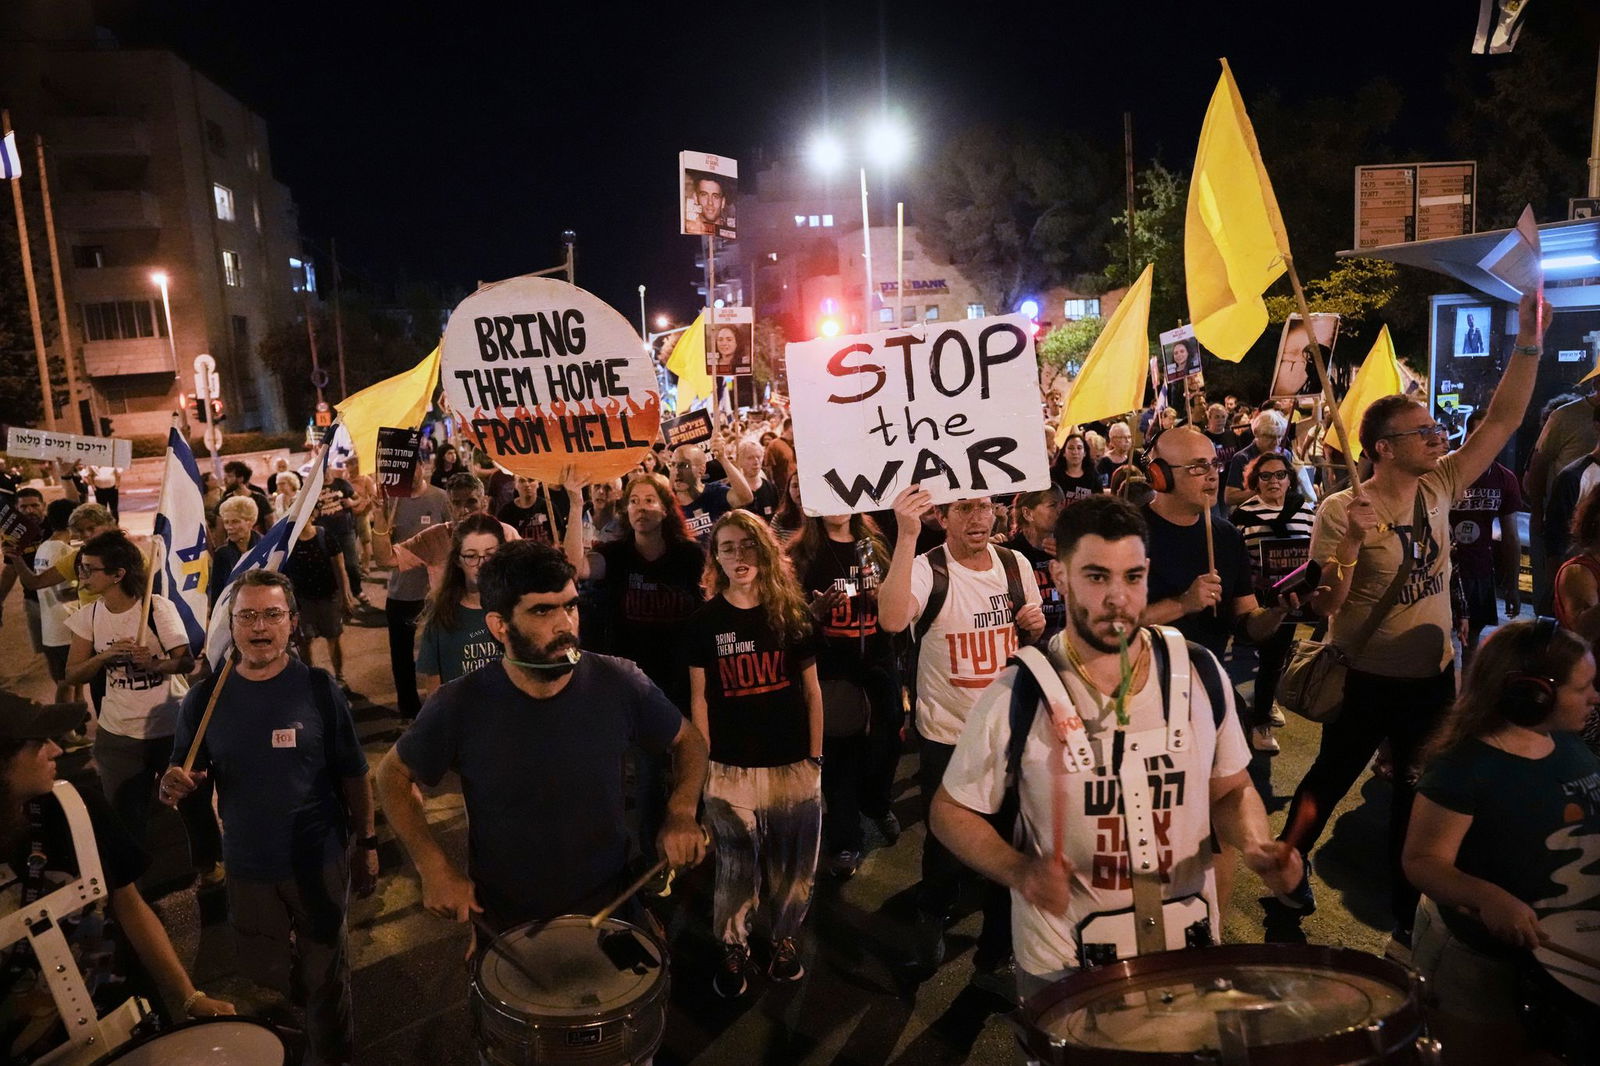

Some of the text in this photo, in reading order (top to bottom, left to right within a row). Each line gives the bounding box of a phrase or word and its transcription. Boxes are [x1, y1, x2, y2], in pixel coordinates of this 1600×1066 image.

[474, 309, 586, 362] BRING
[455, 358, 629, 410] THEM HOME
[826, 323, 1027, 404] STOP
[472, 412, 649, 455] FROM HELL
[868, 406, 975, 446] the
[822, 437, 1027, 509] WAR
[715, 631, 736, 645] BRING
[974, 611, 1004, 629] הביתה
[717, 640, 756, 657] THEM HOME
[719, 650, 787, 689] NOW!
[1085, 771, 1186, 816] הרש
